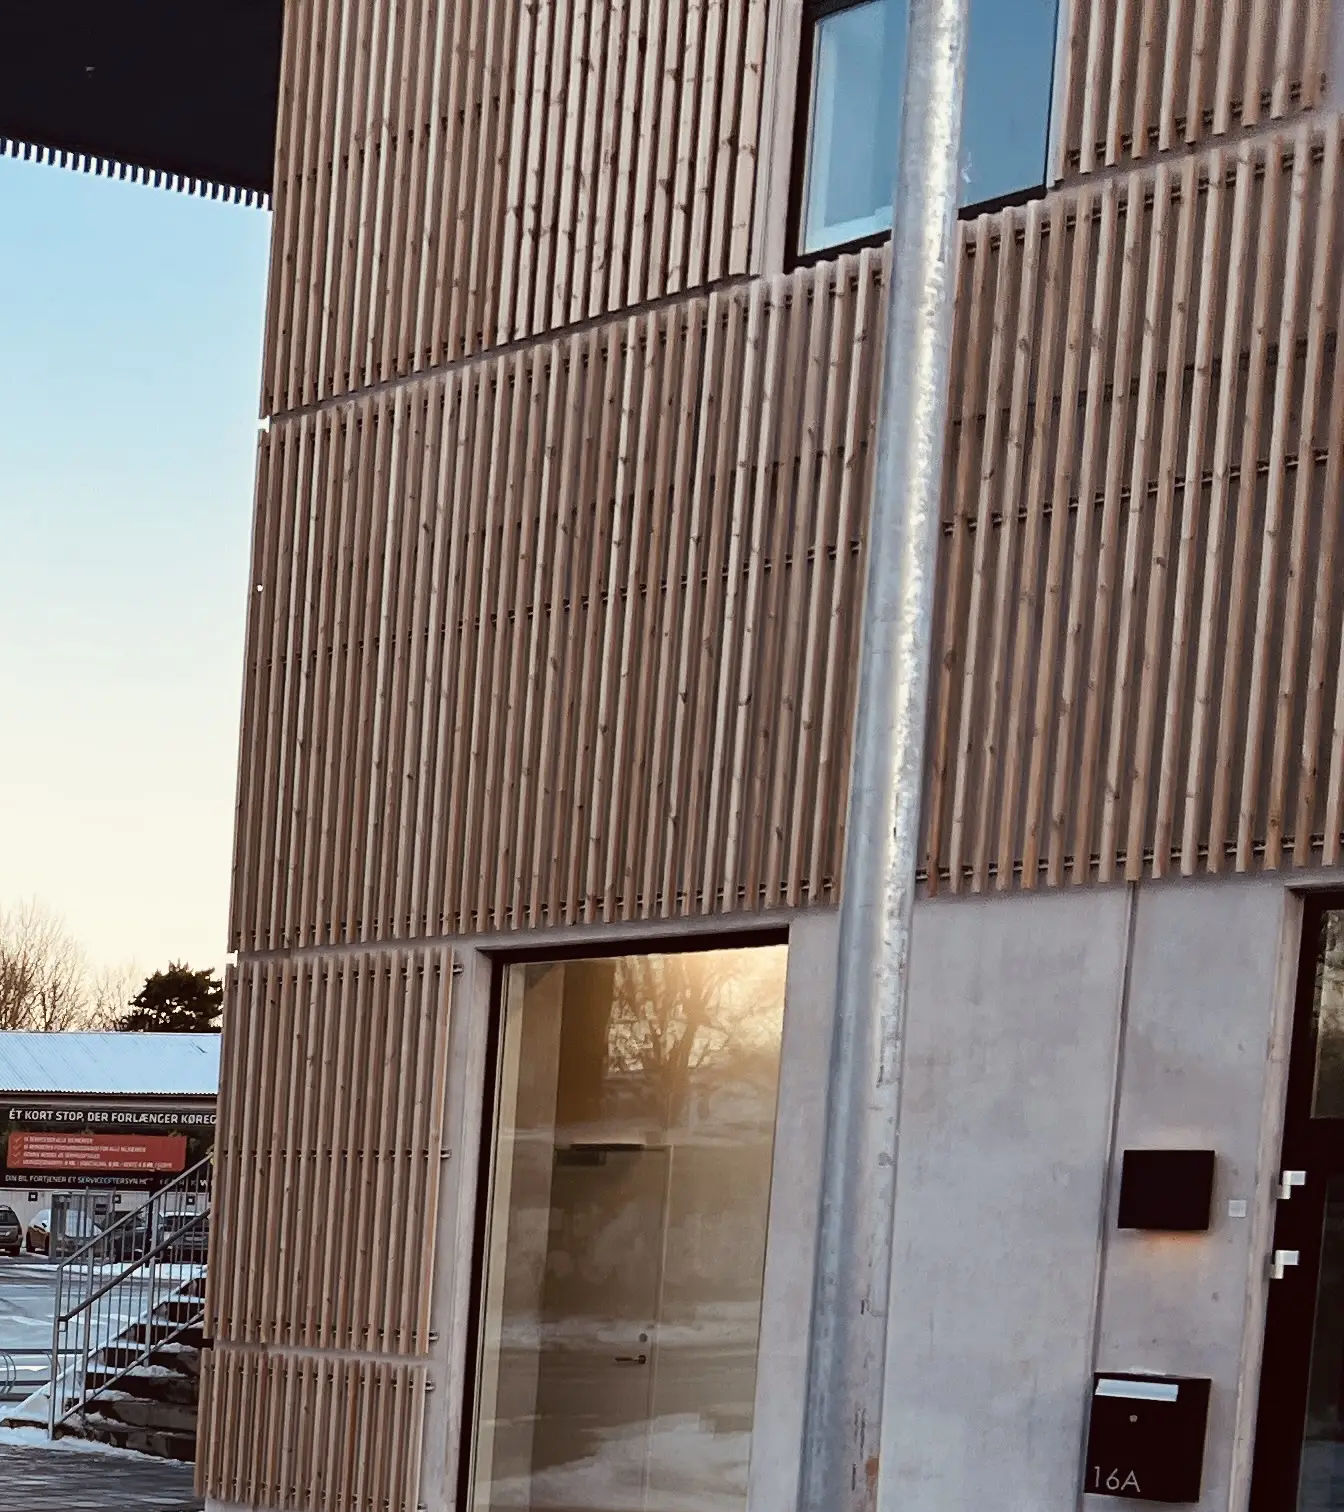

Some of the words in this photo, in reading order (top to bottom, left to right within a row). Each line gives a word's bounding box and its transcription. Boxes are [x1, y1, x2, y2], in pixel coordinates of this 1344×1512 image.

[24, 1110, 53, 1121] KORT
[55, 1111, 85, 1123] STOP,
[87, 1112, 110, 1122] DER
[111, 1112, 178, 1124] FORLÆNGER
[1094, 1466, 1141, 1493] 16A
